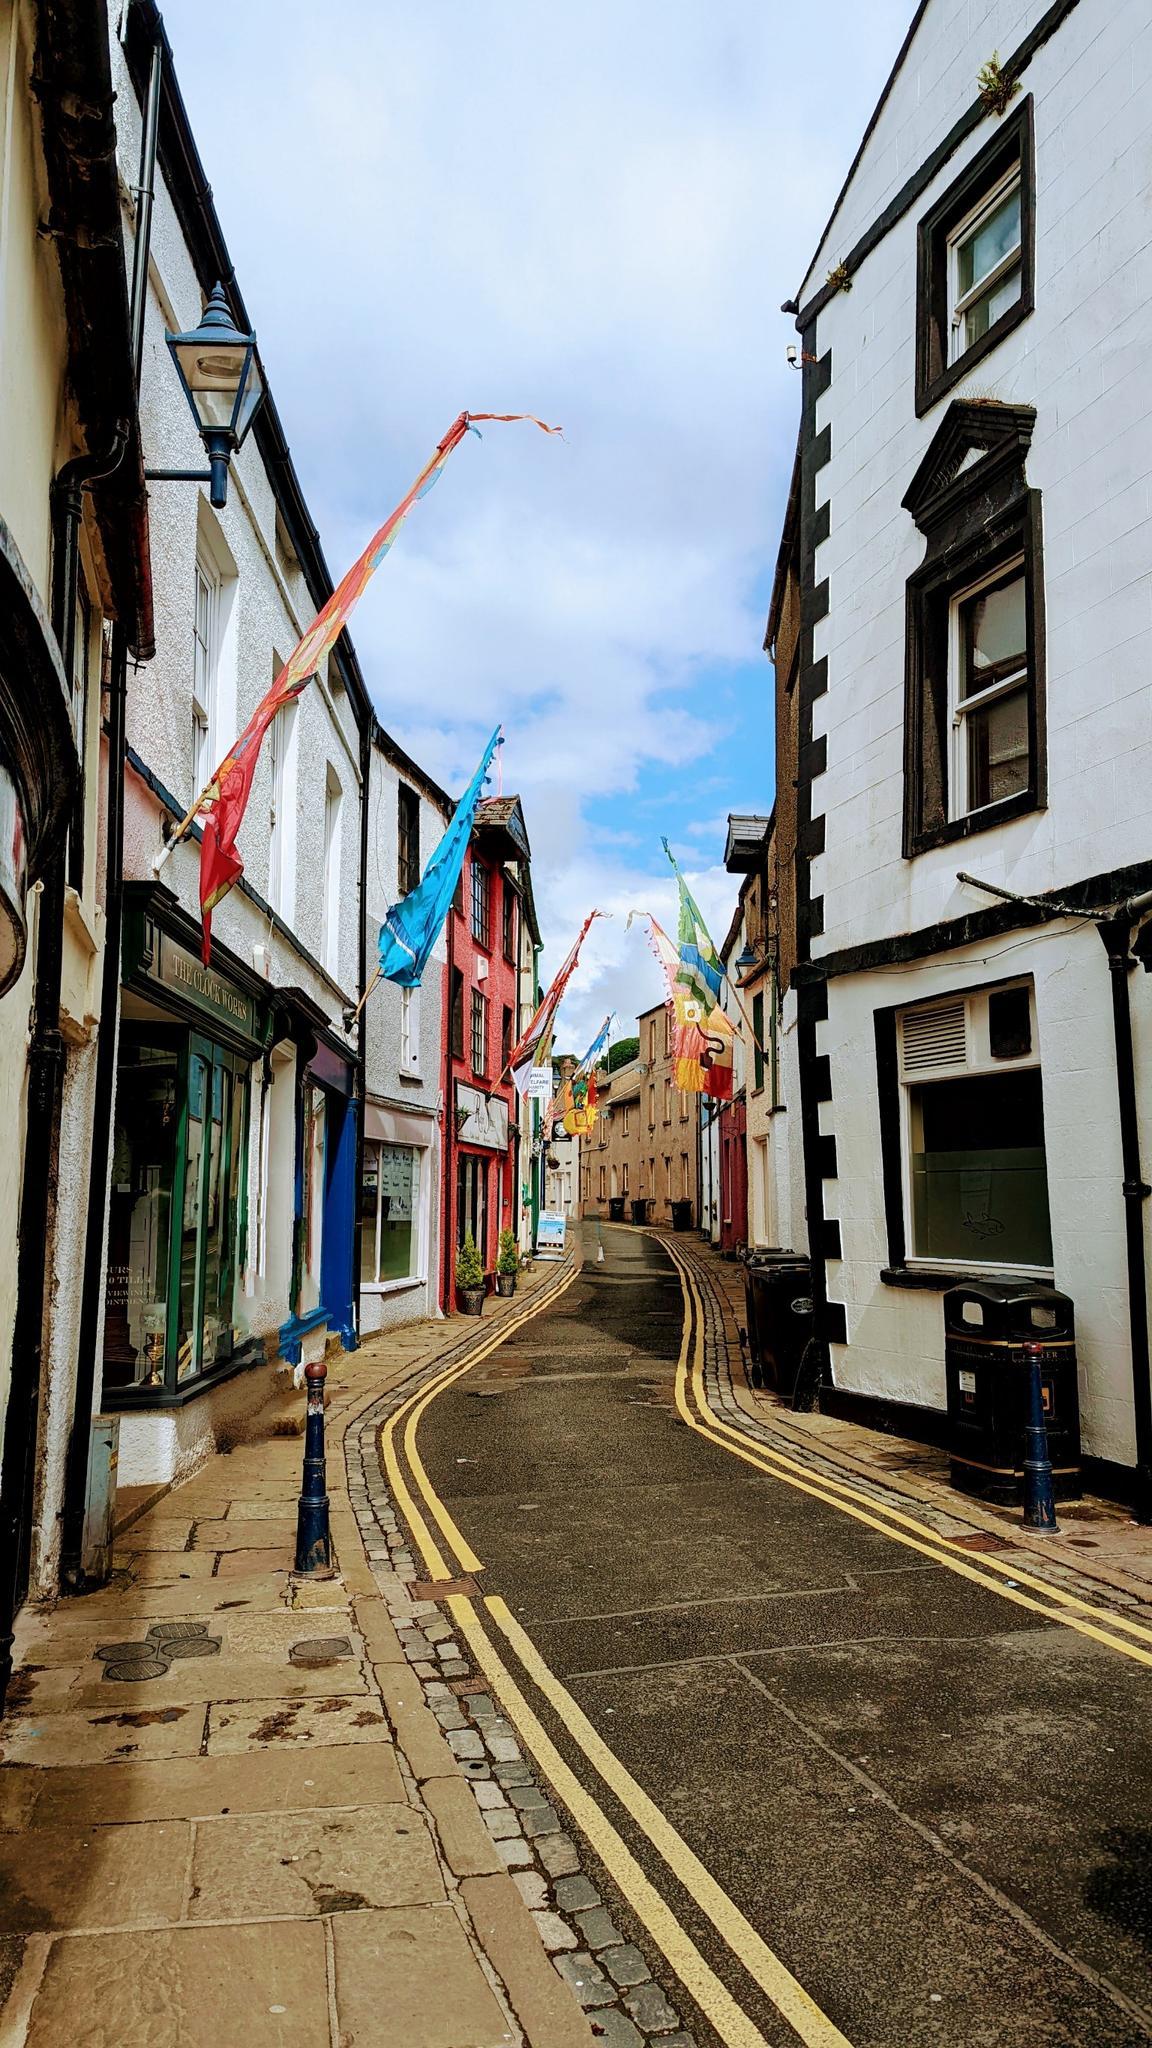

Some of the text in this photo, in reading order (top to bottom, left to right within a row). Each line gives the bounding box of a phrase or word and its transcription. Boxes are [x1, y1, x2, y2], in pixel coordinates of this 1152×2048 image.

[173, 954, 247, 1021] THE CLOCK WORKS
